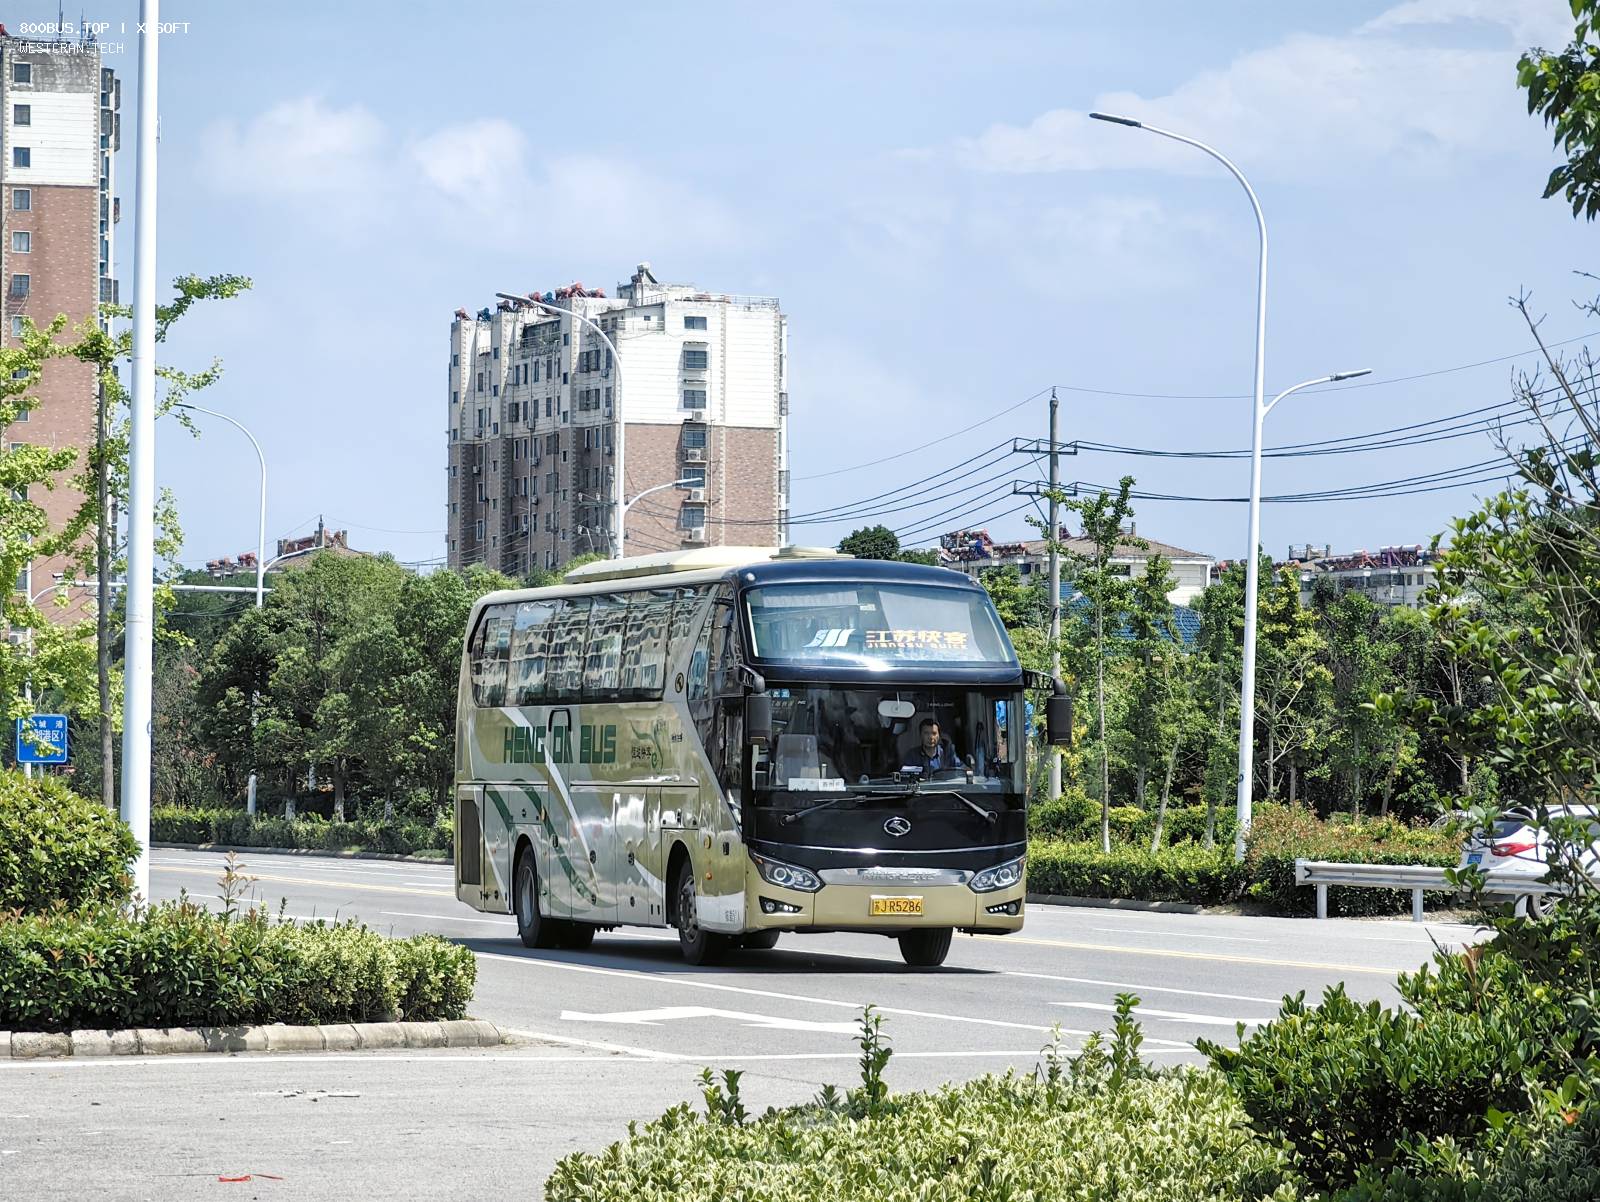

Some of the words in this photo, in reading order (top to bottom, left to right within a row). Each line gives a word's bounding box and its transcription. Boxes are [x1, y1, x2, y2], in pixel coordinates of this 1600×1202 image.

[865, 630, 968, 644] 江苏快客
[503, 726, 547, 763] HENG
[580, 724, 617, 763] BUS
